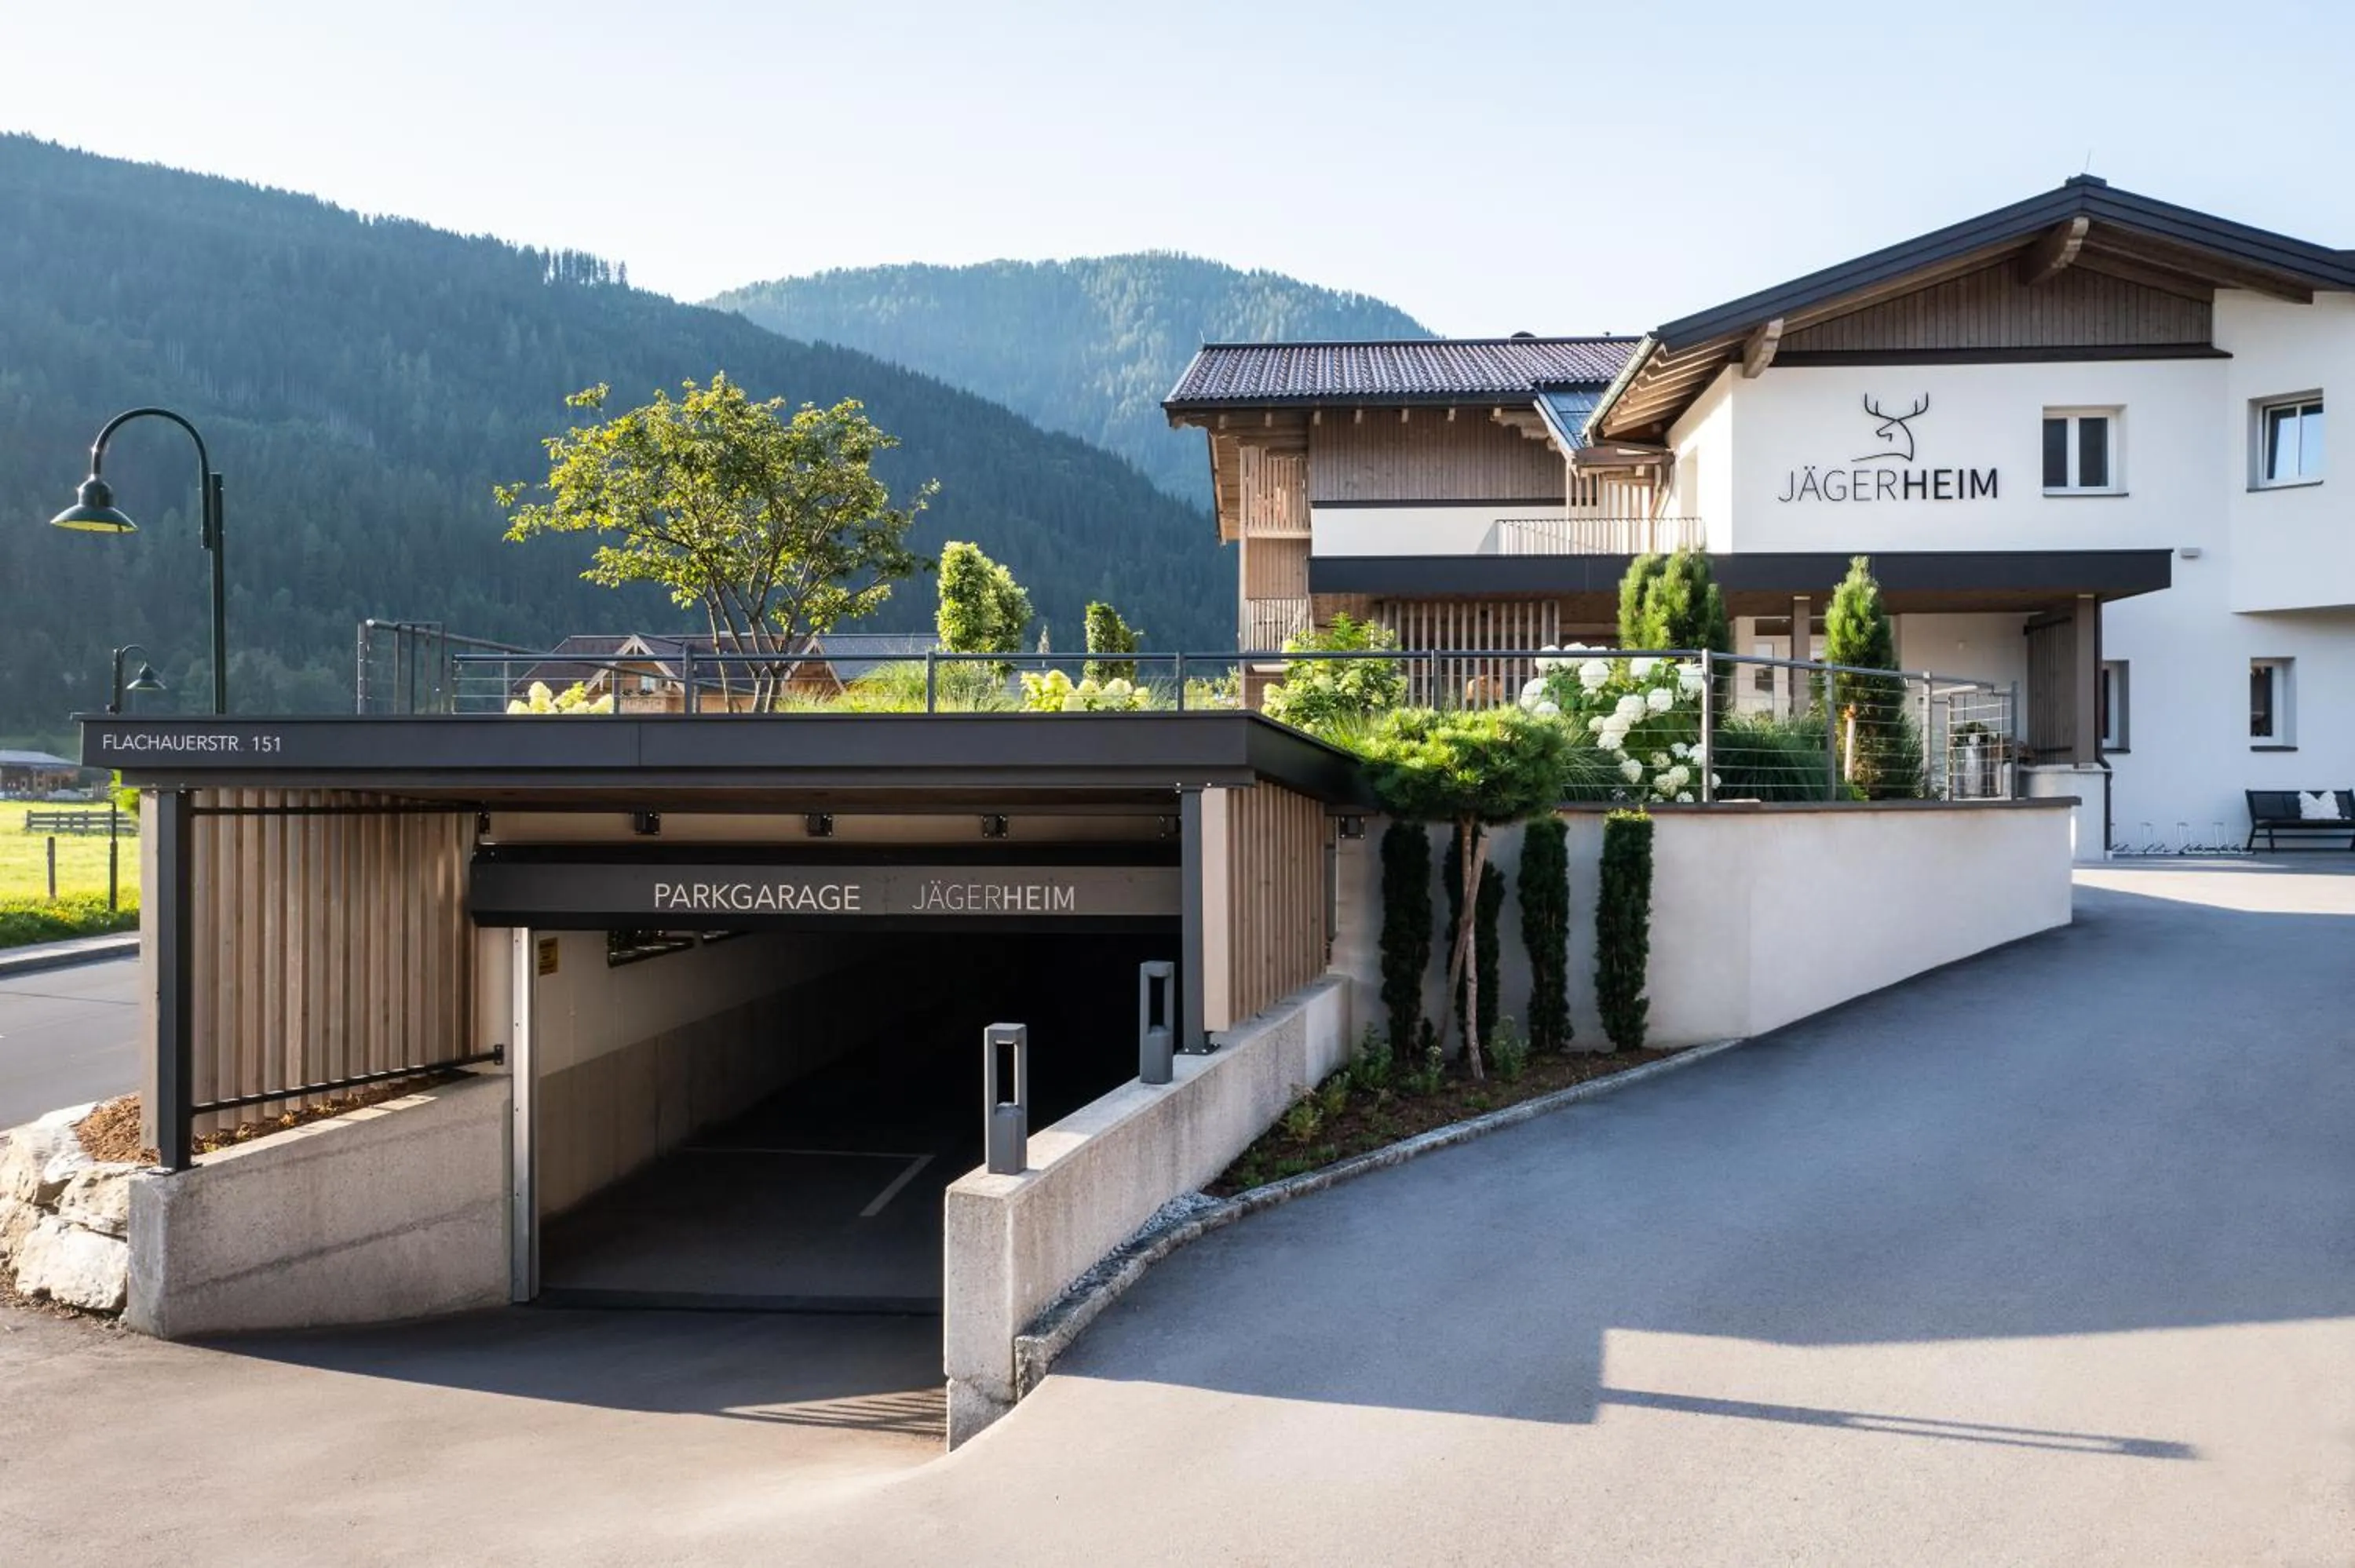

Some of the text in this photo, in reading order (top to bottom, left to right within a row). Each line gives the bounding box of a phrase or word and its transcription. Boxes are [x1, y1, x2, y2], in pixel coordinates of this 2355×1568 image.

[1778, 465, 1998, 502] JÄGERHEIM
[252, 736, 280, 752] 151
[654, 880, 1076, 910] PARKGARAGE JÄGERHEIM
